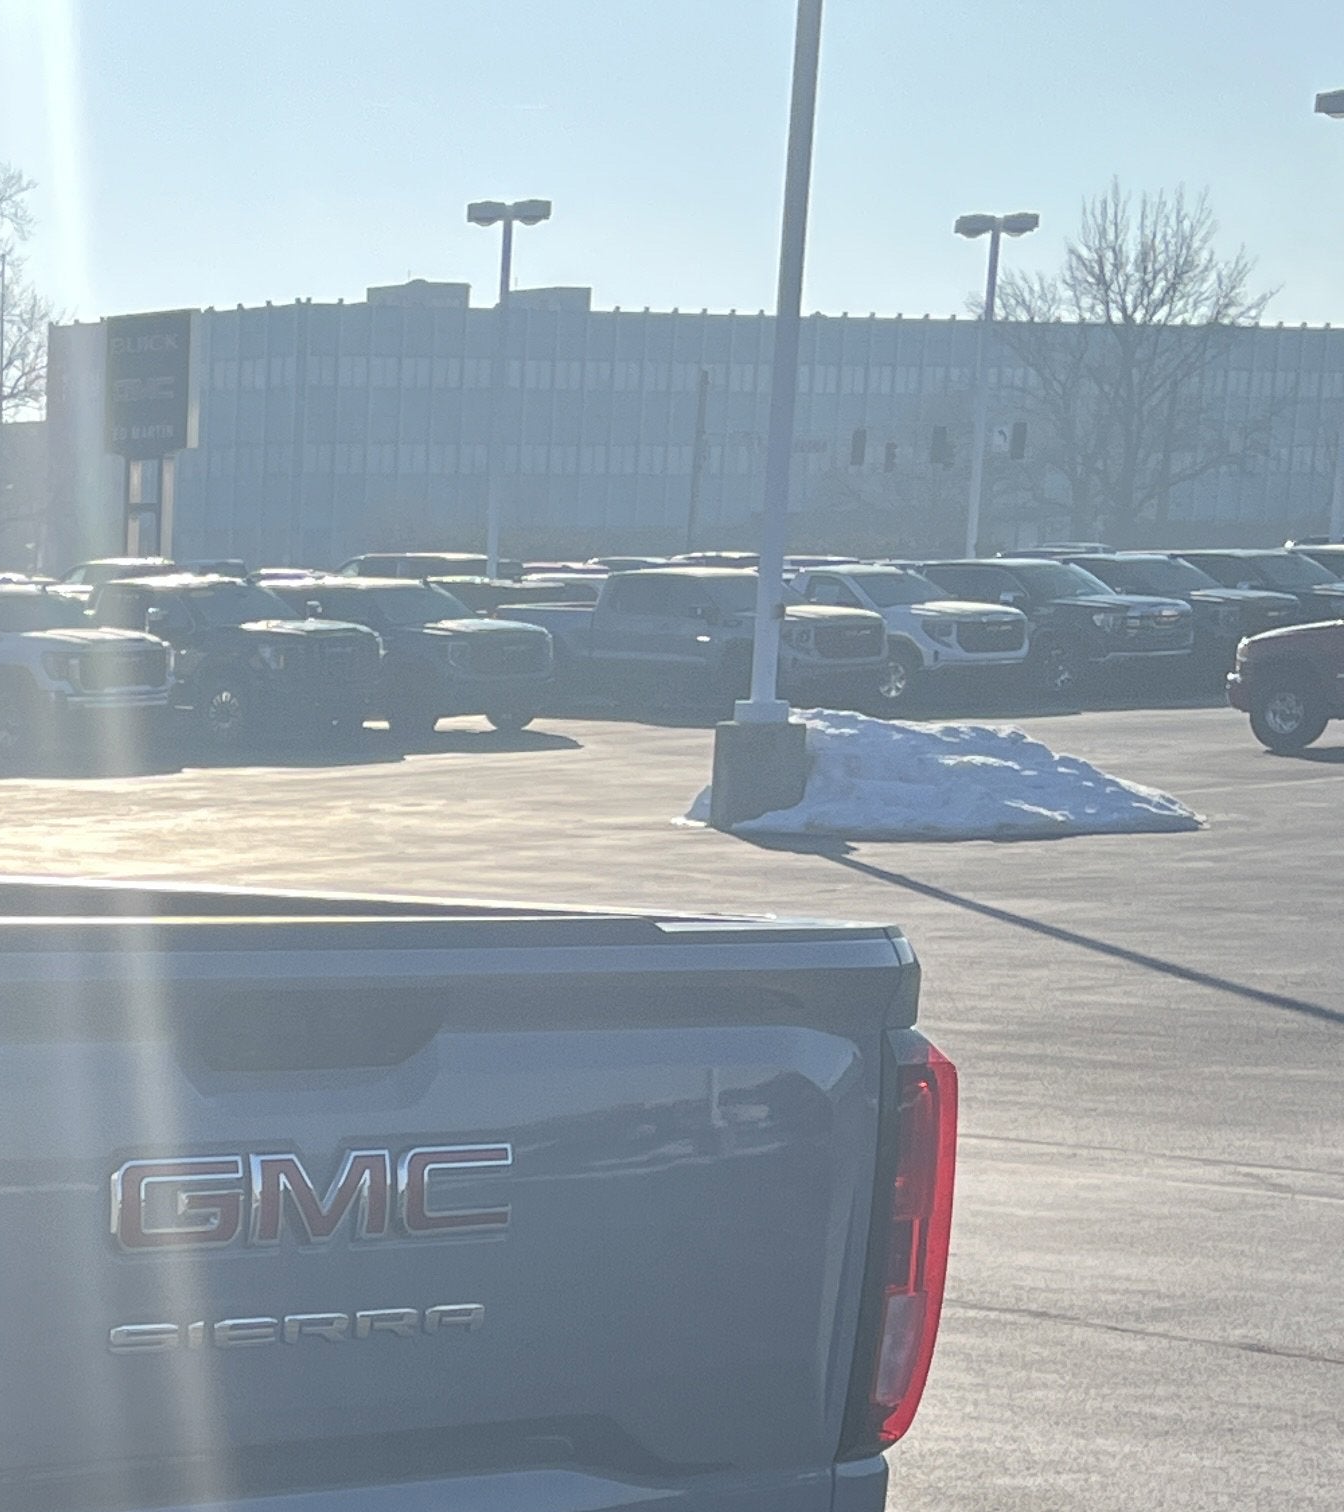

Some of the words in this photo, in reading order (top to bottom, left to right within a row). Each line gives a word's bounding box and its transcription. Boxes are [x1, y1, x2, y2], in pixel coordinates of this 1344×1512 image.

[110, 333, 179, 355] BUICK
[110, 1143, 513, 1255] GMC
[109, 1303, 486, 1354] SIERRA
